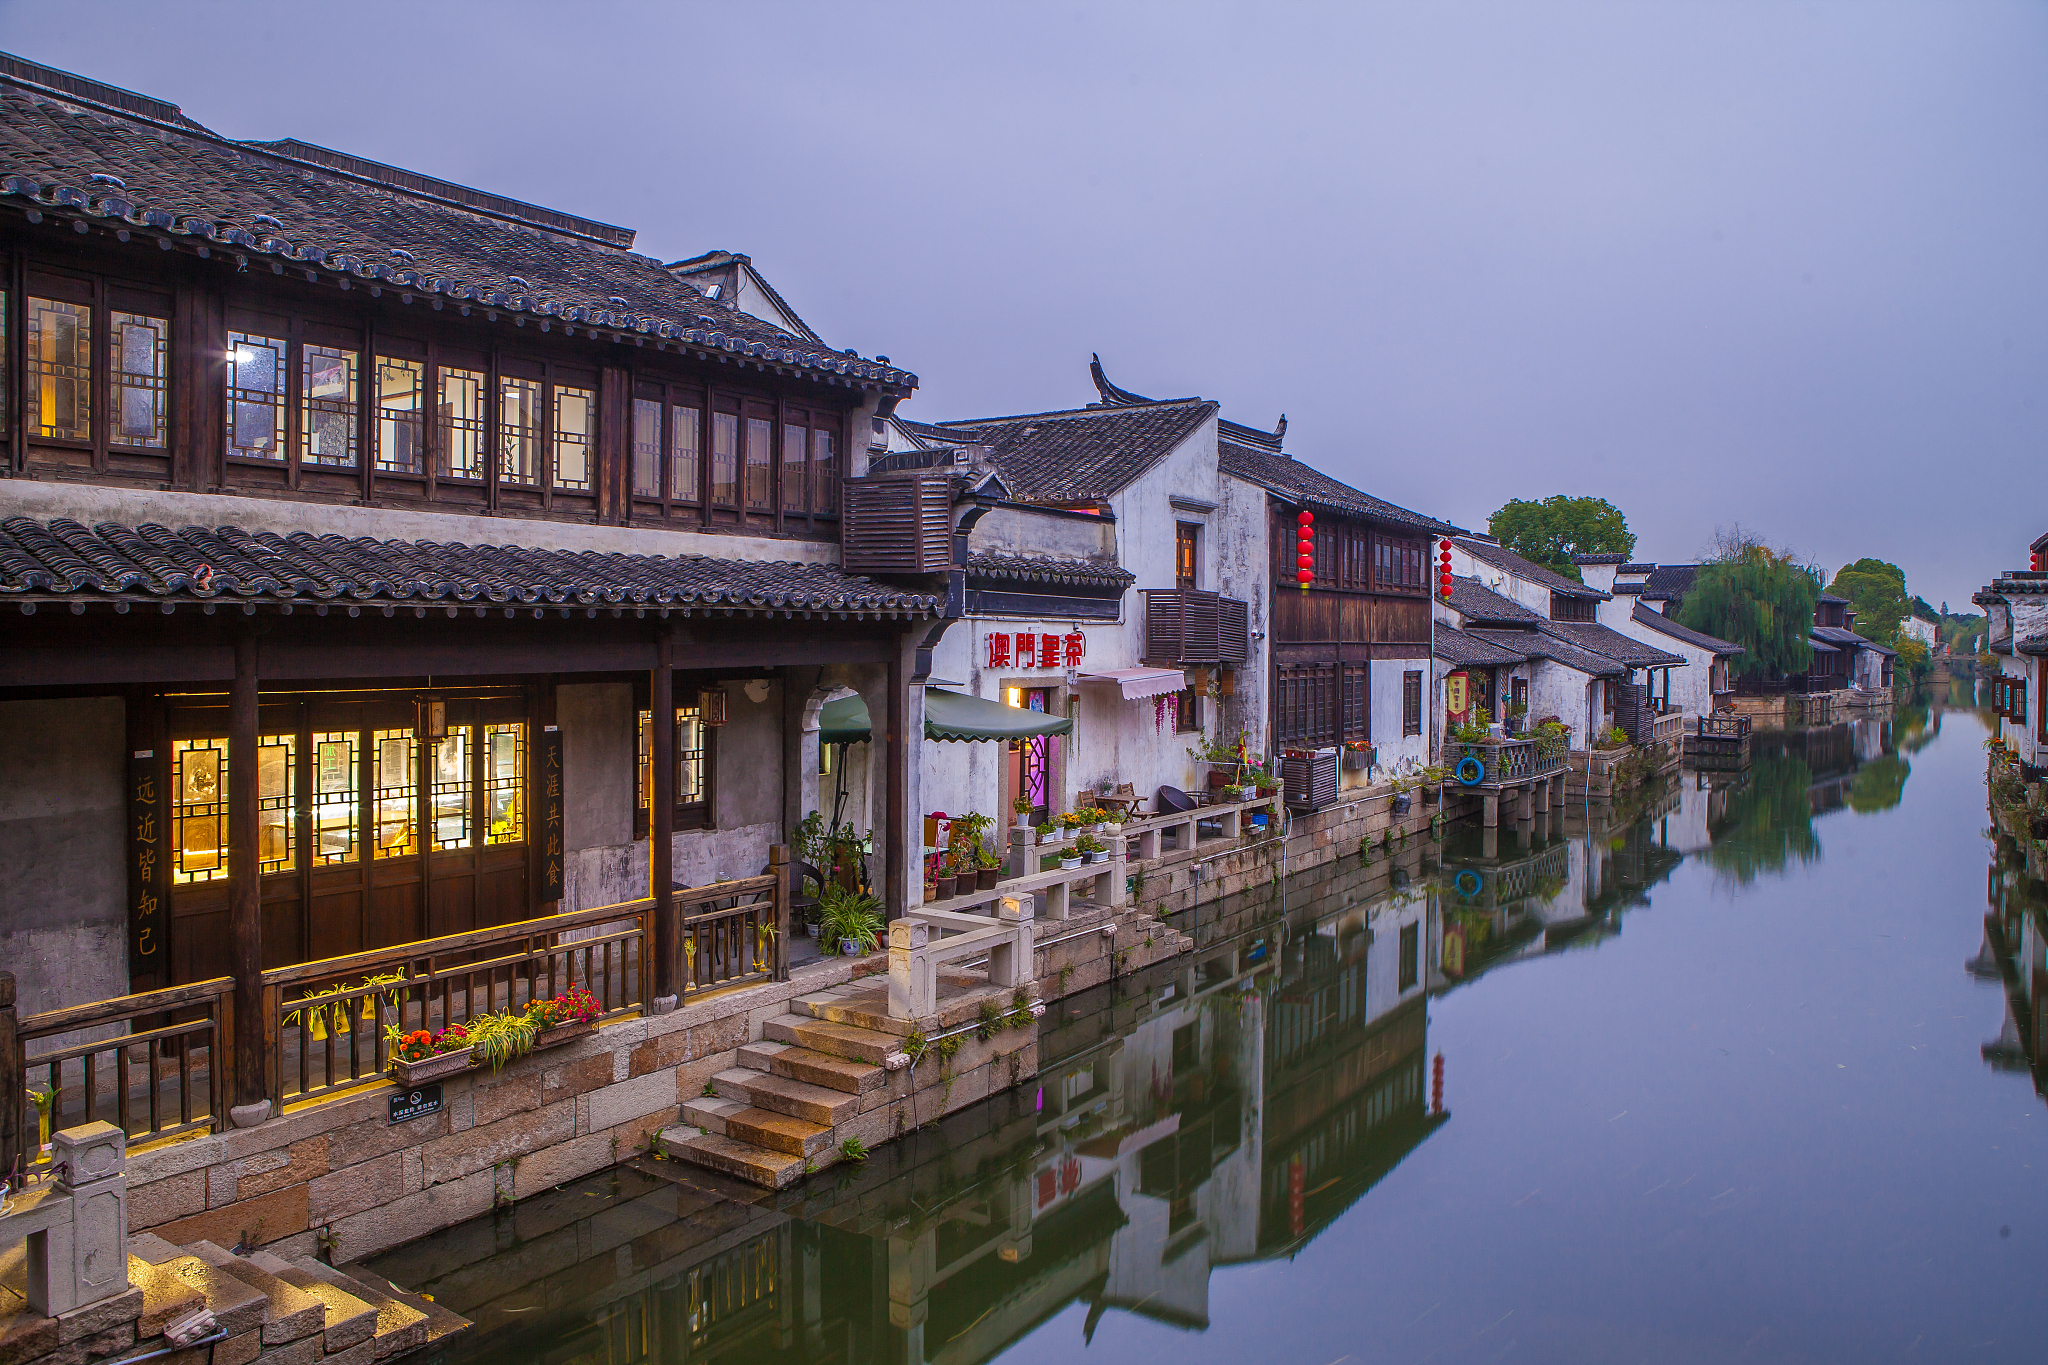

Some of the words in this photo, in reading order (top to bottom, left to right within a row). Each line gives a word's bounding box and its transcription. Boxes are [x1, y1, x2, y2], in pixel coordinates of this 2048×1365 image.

[988, 632, 1083, 668] 澳門皇茶
[135, 775, 158, 955] 远近皆知己
[546, 745, 561, 887] 天涯共此食
